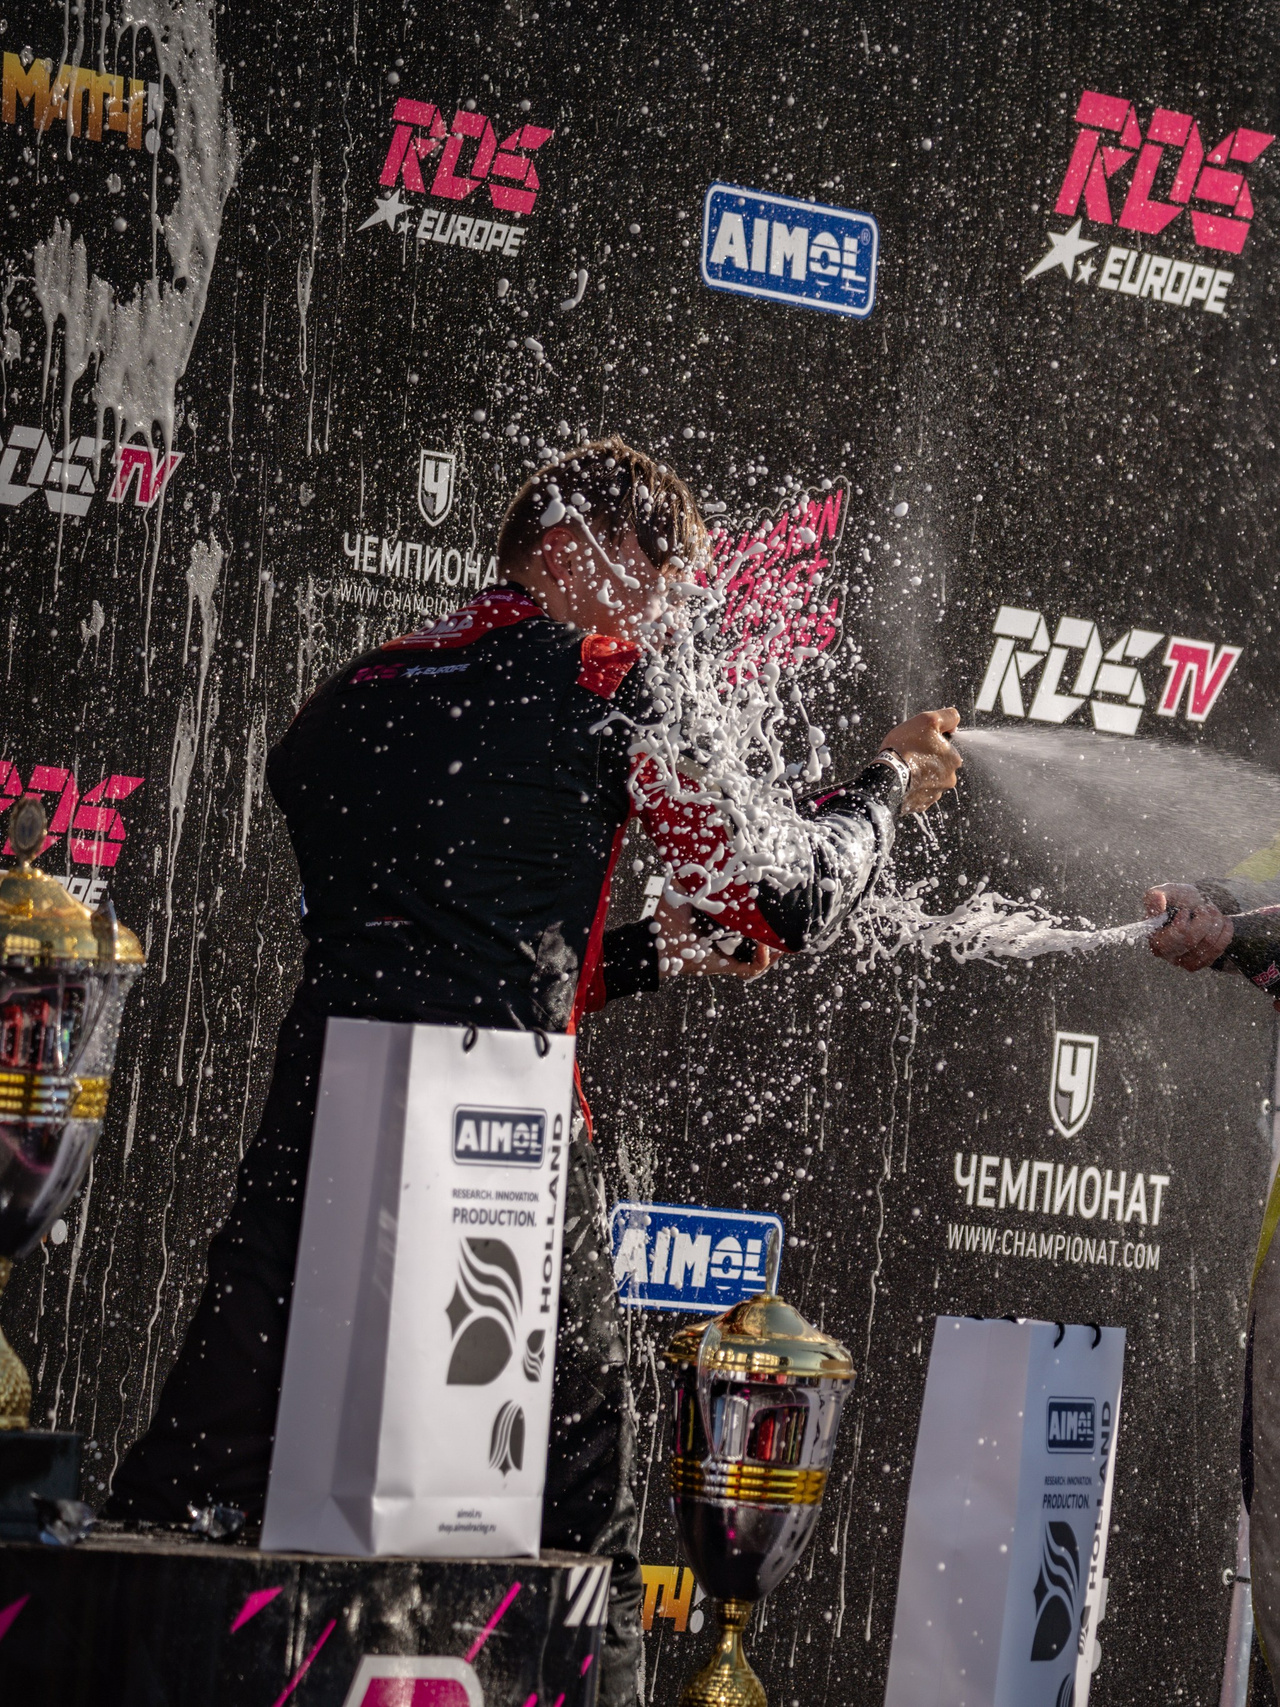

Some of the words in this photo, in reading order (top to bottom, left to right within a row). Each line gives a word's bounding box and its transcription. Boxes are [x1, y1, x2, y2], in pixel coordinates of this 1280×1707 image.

[379, 97, 554, 215] RDS
[1054, 89, 1275, 254] RDS
[417, 208, 526, 257] EUROPE
[709, 211, 867, 294] AIMOL
[1099, 245, 1235, 314] EUROPE
[0, 424, 112, 517] DS
[106, 442, 186, 508] TV
[343, 531, 498, 590] ЧЕМПИОНА
[422, 663, 471, 676] EUROPE
[974, 605, 1166, 736] RDS
[1156, 635, 1245, 723] TV
[457, 1119, 543, 1155] AIMOL
[452, 1188, 493, 1200] RESEARCH.
[452, 1207, 537, 1227] PRODUCTION.
[540, 1113, 563, 1314] HOLLAND
[954, 1152, 1170, 1226] ЧЕМПИОНАТ
[613, 1228, 767, 1292] AIMOL
[948, 1223, 1160, 1271] WWW.CHAMPIONAT.COM
[1049, 1410, 1094, 1442] AIMOL
[640, 1564, 705, 1634] ТЧ!
